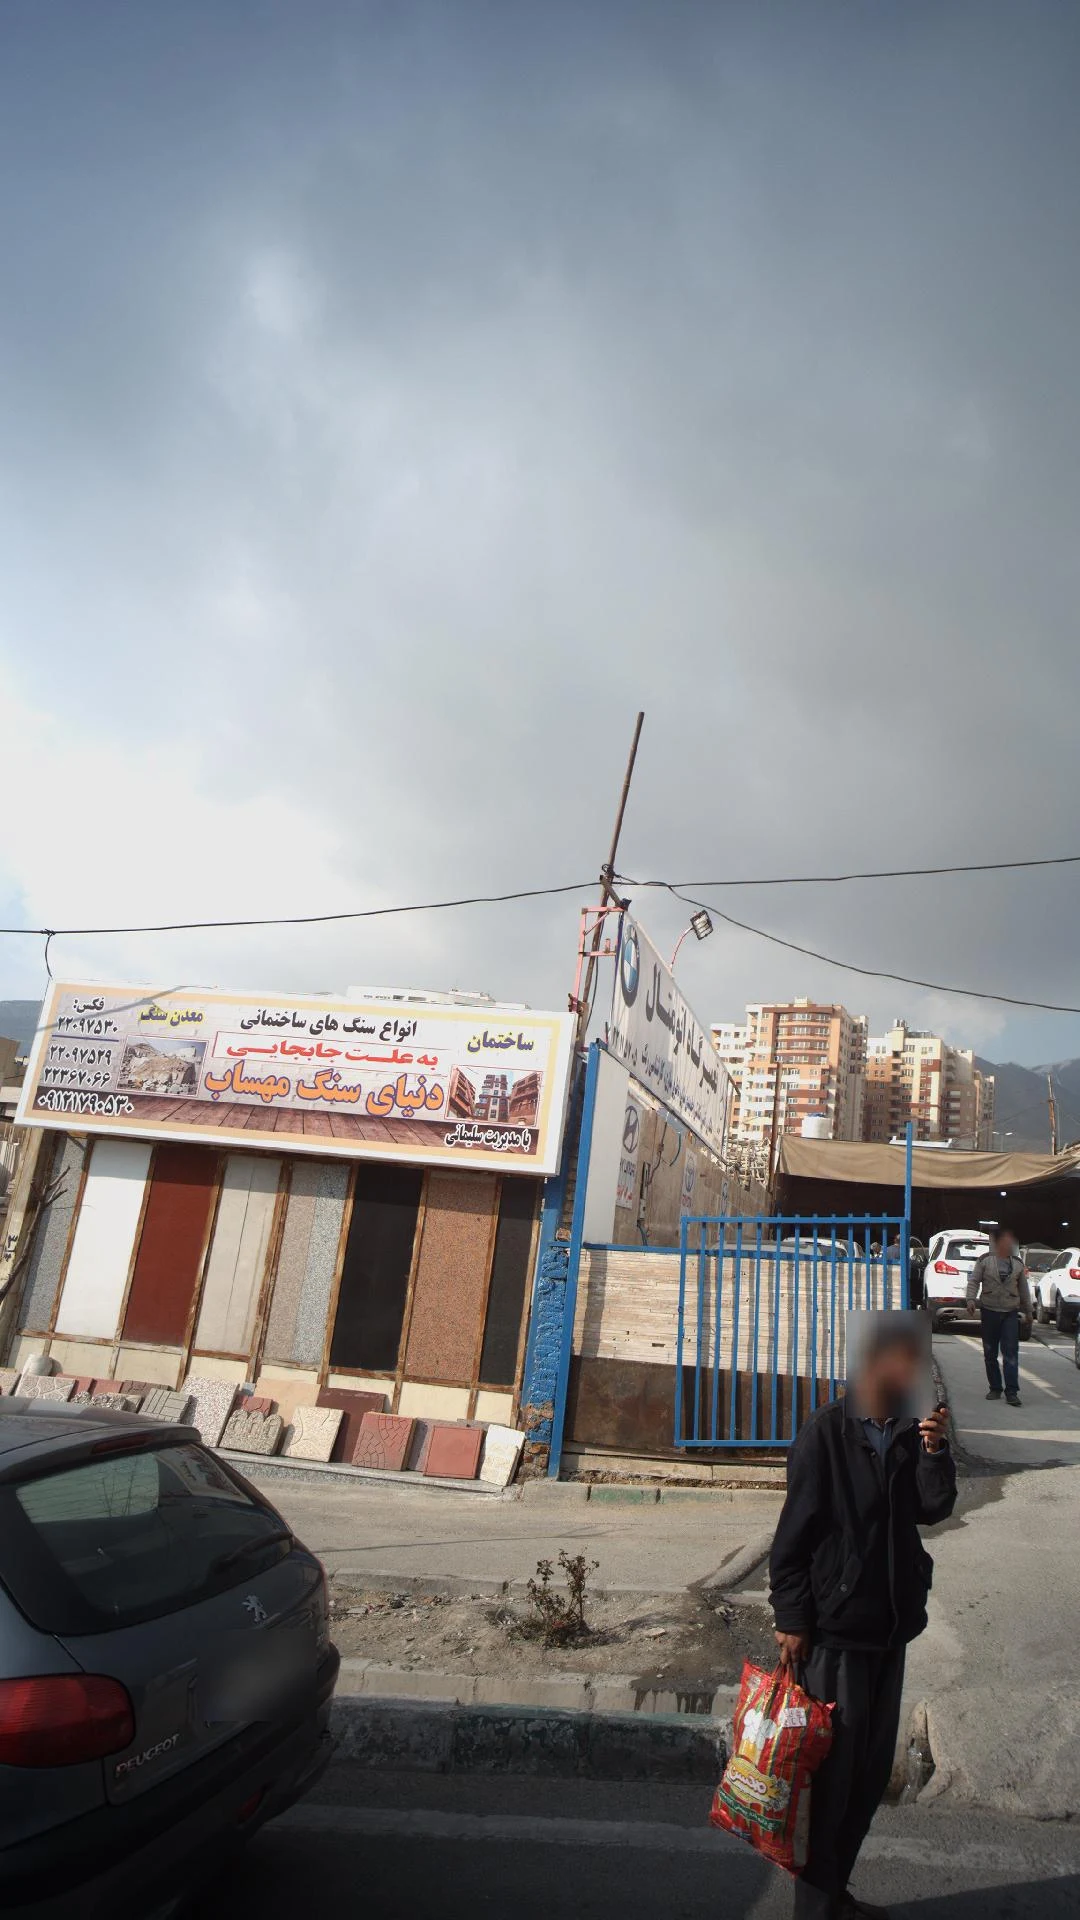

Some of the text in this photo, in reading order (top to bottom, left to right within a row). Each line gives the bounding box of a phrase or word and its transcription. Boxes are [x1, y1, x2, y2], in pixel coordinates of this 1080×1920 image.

[73, 997, 105, 1013] فکس:
[140, 1006, 204, 1026] معدن سنگ
[57, 1016, 118, 1035] ۲۲۰۹۷۵۳۰
[240, 1009, 417, 1043] انواع سنگ های ساختمانی
[467, 1030, 534, 1053] ساختمان
[49, 1045, 112, 1066] ۲۲۰۹۷۵۲۹
[226, 1039, 438, 1071] به علت جابجایی
[44, 1067, 111, 1088] ۲۲۳۶۷۰۶۶
[203, 1060, 445, 1117] دنیای سنگ مهساب
[39, 1090, 134, 1116] ۰۹۱۲۱۷۹۰۵۳۰
[445, 1124, 532, 1152] با مدیریت سلیمانی
[115, 1733, 180, 1778] PEUGEOT
